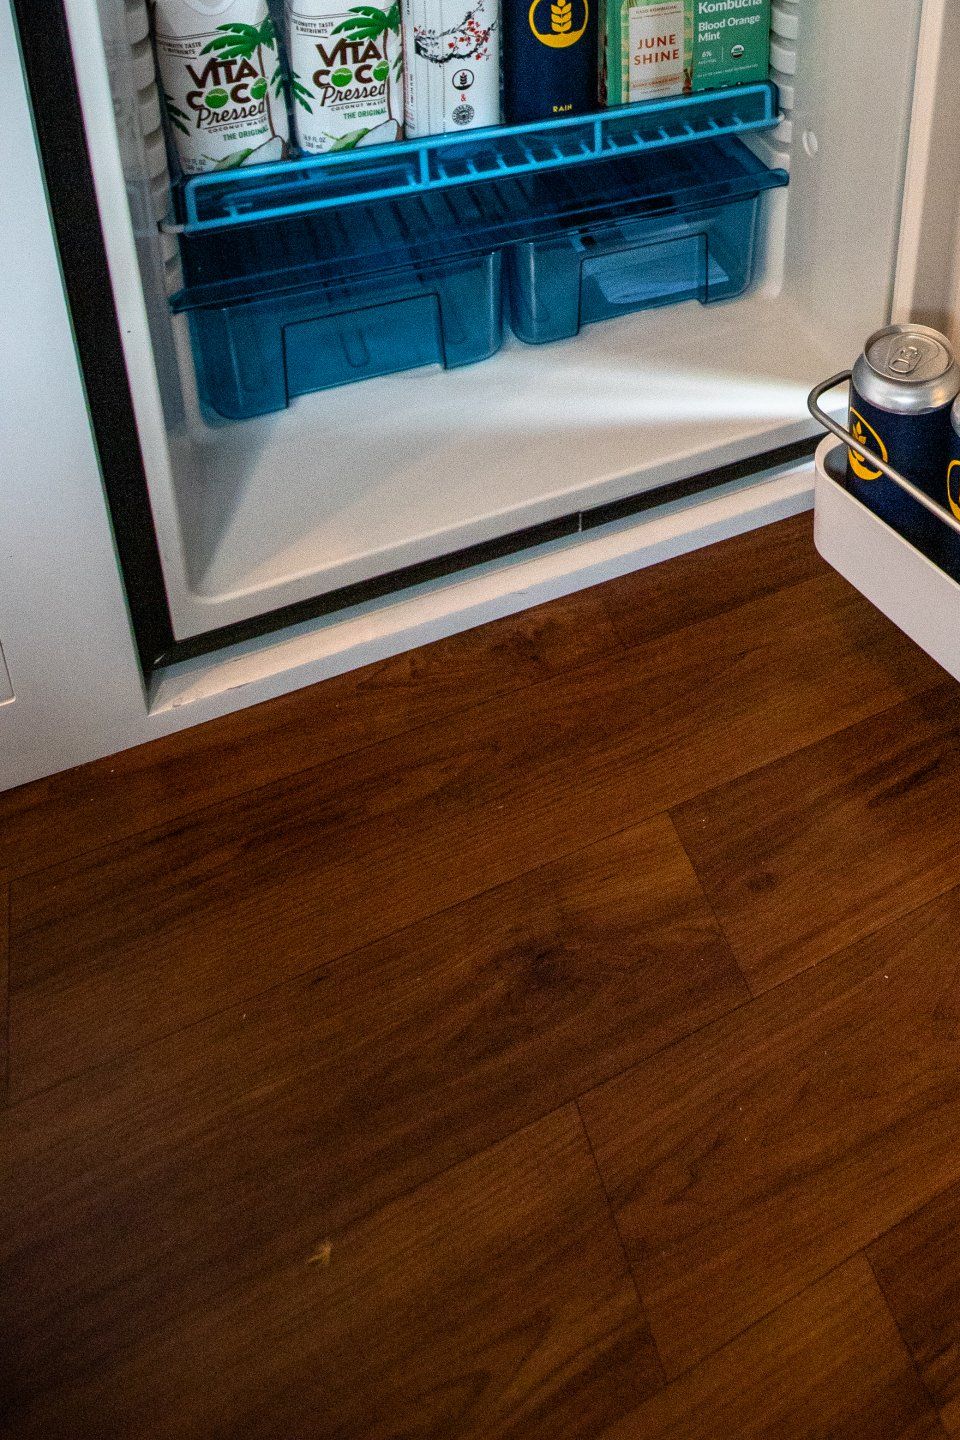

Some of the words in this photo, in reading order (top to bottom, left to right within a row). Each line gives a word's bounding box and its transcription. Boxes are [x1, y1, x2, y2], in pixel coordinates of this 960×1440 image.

[698, 18, 726, 31] Blood
[727, 14, 761, 26] Orange
[637, 34, 676, 49] JUNE
[698, 31, 720, 42] Mint
[315, 38, 382, 67] VITA
[634, 48, 680, 65] SHINE
[185, 57, 260, 88] VITA
[312, 60, 390, 90] COCO
[186, 77, 267, 111] COCO
[320, 80, 386, 106] Pressed
[197, 97, 266, 128] Pressed
[331, 103, 364, 111] COCONUT
[343, 110, 356, 119] THE
[357, 107, 387, 118] ORIGINAL
[552, 104, 573, 113] RAIN
[222, 131, 238, 140] THE
[239, 125, 268, 138] ORIGINAL
